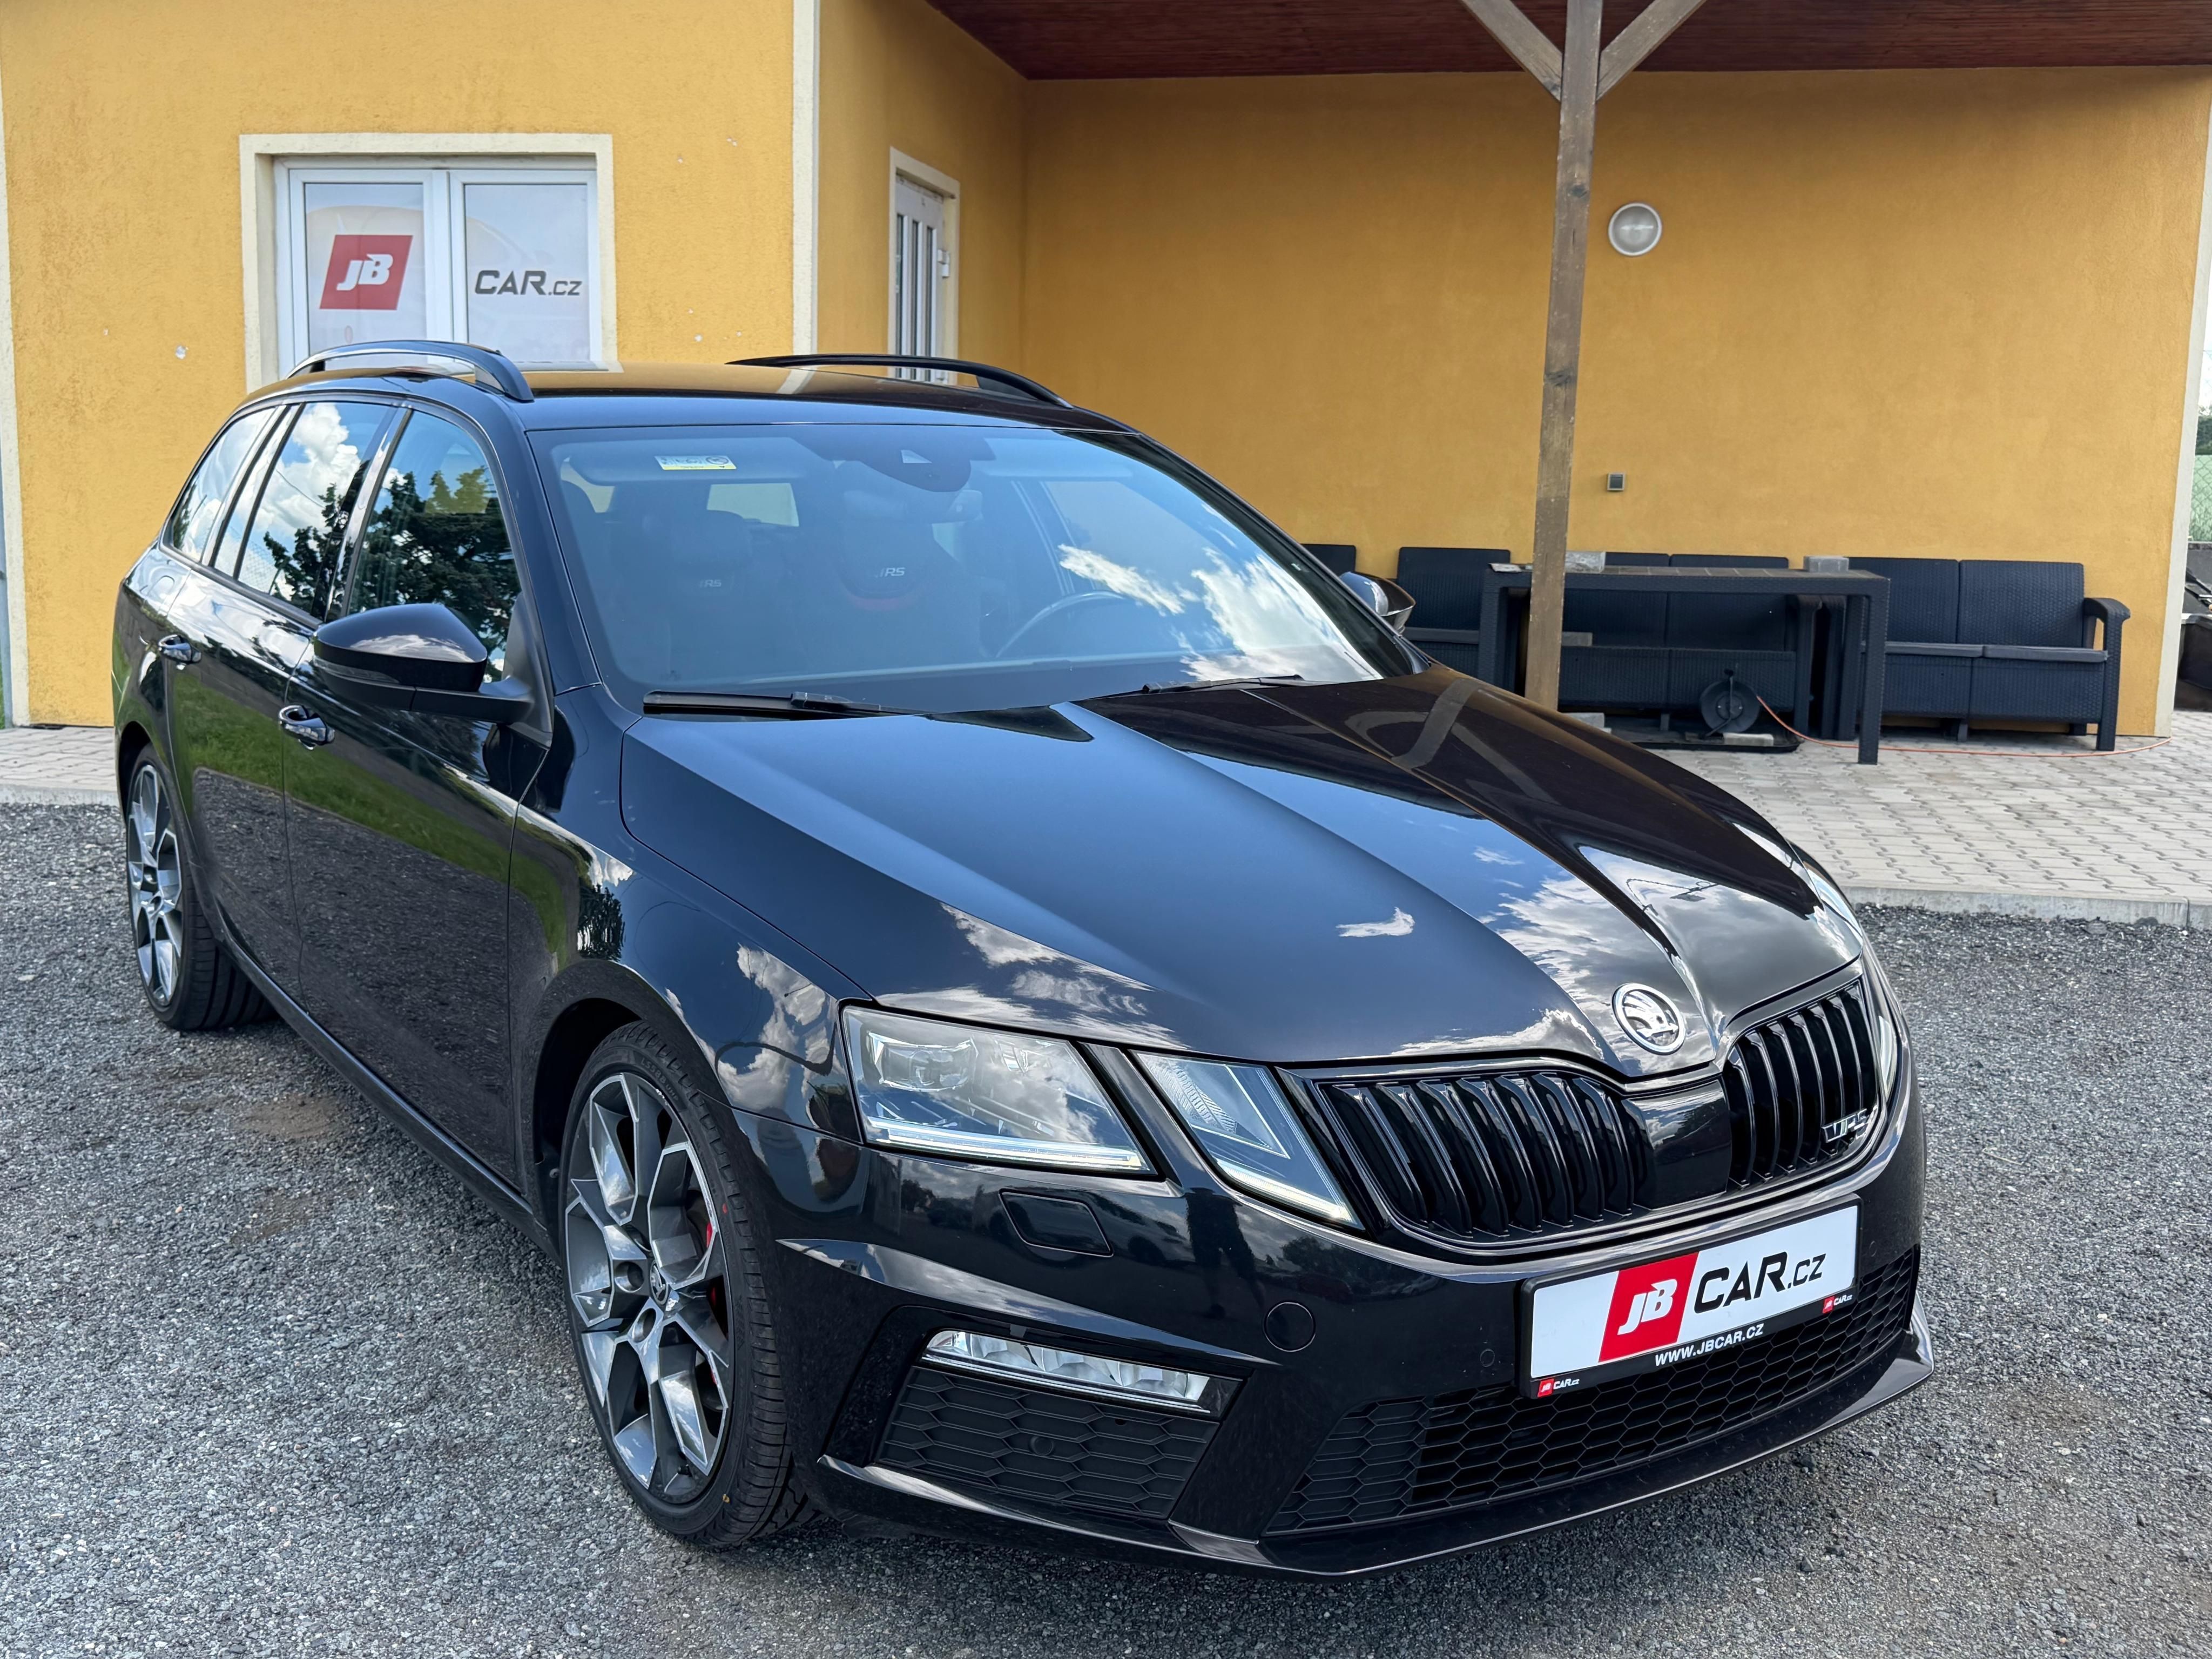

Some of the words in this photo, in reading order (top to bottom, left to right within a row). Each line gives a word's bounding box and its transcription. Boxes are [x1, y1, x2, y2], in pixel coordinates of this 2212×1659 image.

[336, 253, 394, 291] JB
[640, 1057, 666, 1084] LS588
[1617, 1278, 1678, 1336] JB
[1655, 1323, 1764, 1367] WWW.JBCAR.CZ
